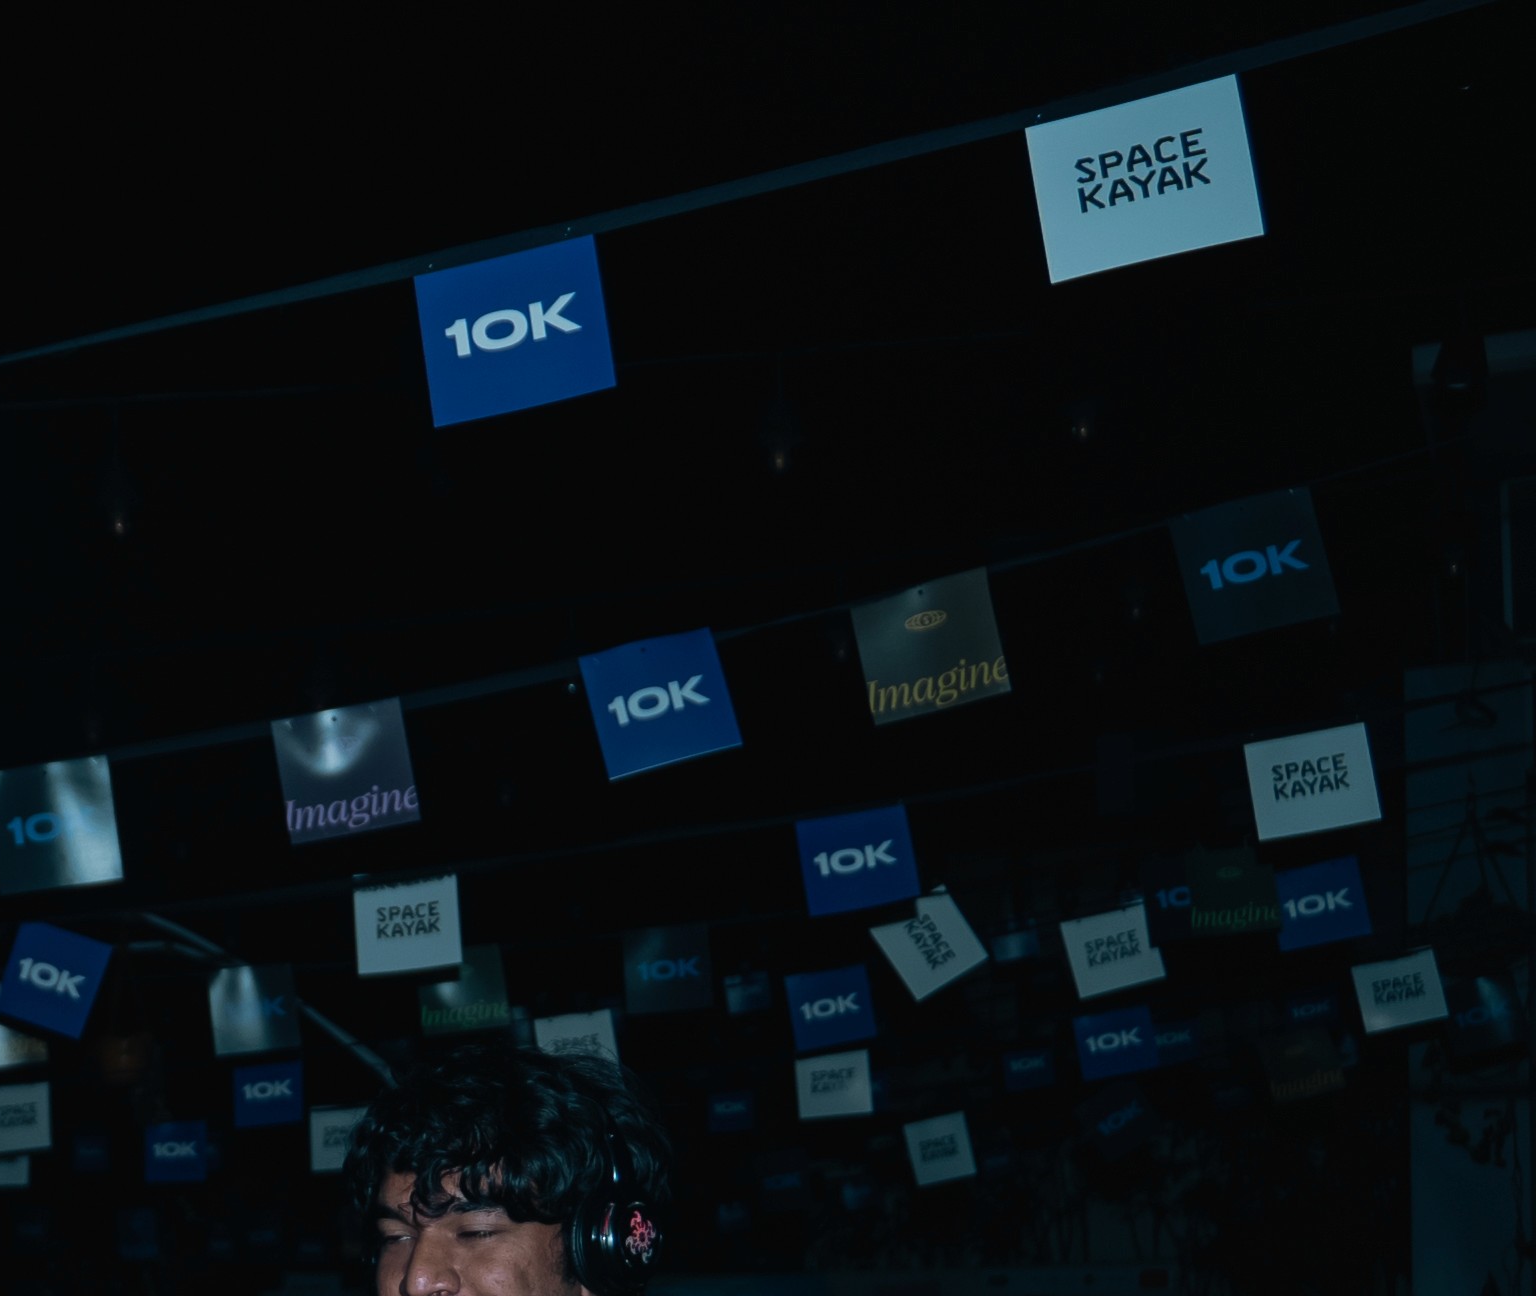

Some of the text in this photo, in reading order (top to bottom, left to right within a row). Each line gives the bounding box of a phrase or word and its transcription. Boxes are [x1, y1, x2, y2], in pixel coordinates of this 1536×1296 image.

[1074, 126, 1209, 187] SPACE
[1077, 157, 1214, 214] KAYAK
[443, 290, 584, 360] 10K
[1199, 536, 1312, 592] 10K
[867, 650, 1009, 719] Imagine
[606, 671, 712, 730] 10K
[1271, 753, 1346, 783] SPACE
[1273, 771, 1350, 804] KAYAK
[285, 784, 419, 833] Imagine
[4, 811, 62, 847] 10
[813, 838, 898, 879] 10K
[376, 900, 440, 923] SPACE
[1155, 886, 1192, 910] 10
[1283, 888, 1352, 919] 10K
[376, 917, 441, 940] KAYAK
[920, 912, 957, 963] SPACE
[1083, 928, 1138, 955] SPACE
[902, 918, 946, 971] KAYAK
[1087, 943, 1143, 968] KAYAK
[18, 956, 86, 1000] 10K
[637, 956, 702, 984] 10K
[1372, 972, 1424, 994] SPACE
[800, 991, 862, 1023] 10K
[1375, 983, 1427, 1008] KAYAK
[1455, 1005, 1491, 1029] 10
[1085, 1025, 1144, 1055] 10K
[242, 1079, 294, 1101] 10K
[152, 1140, 199, 1159] 10K
